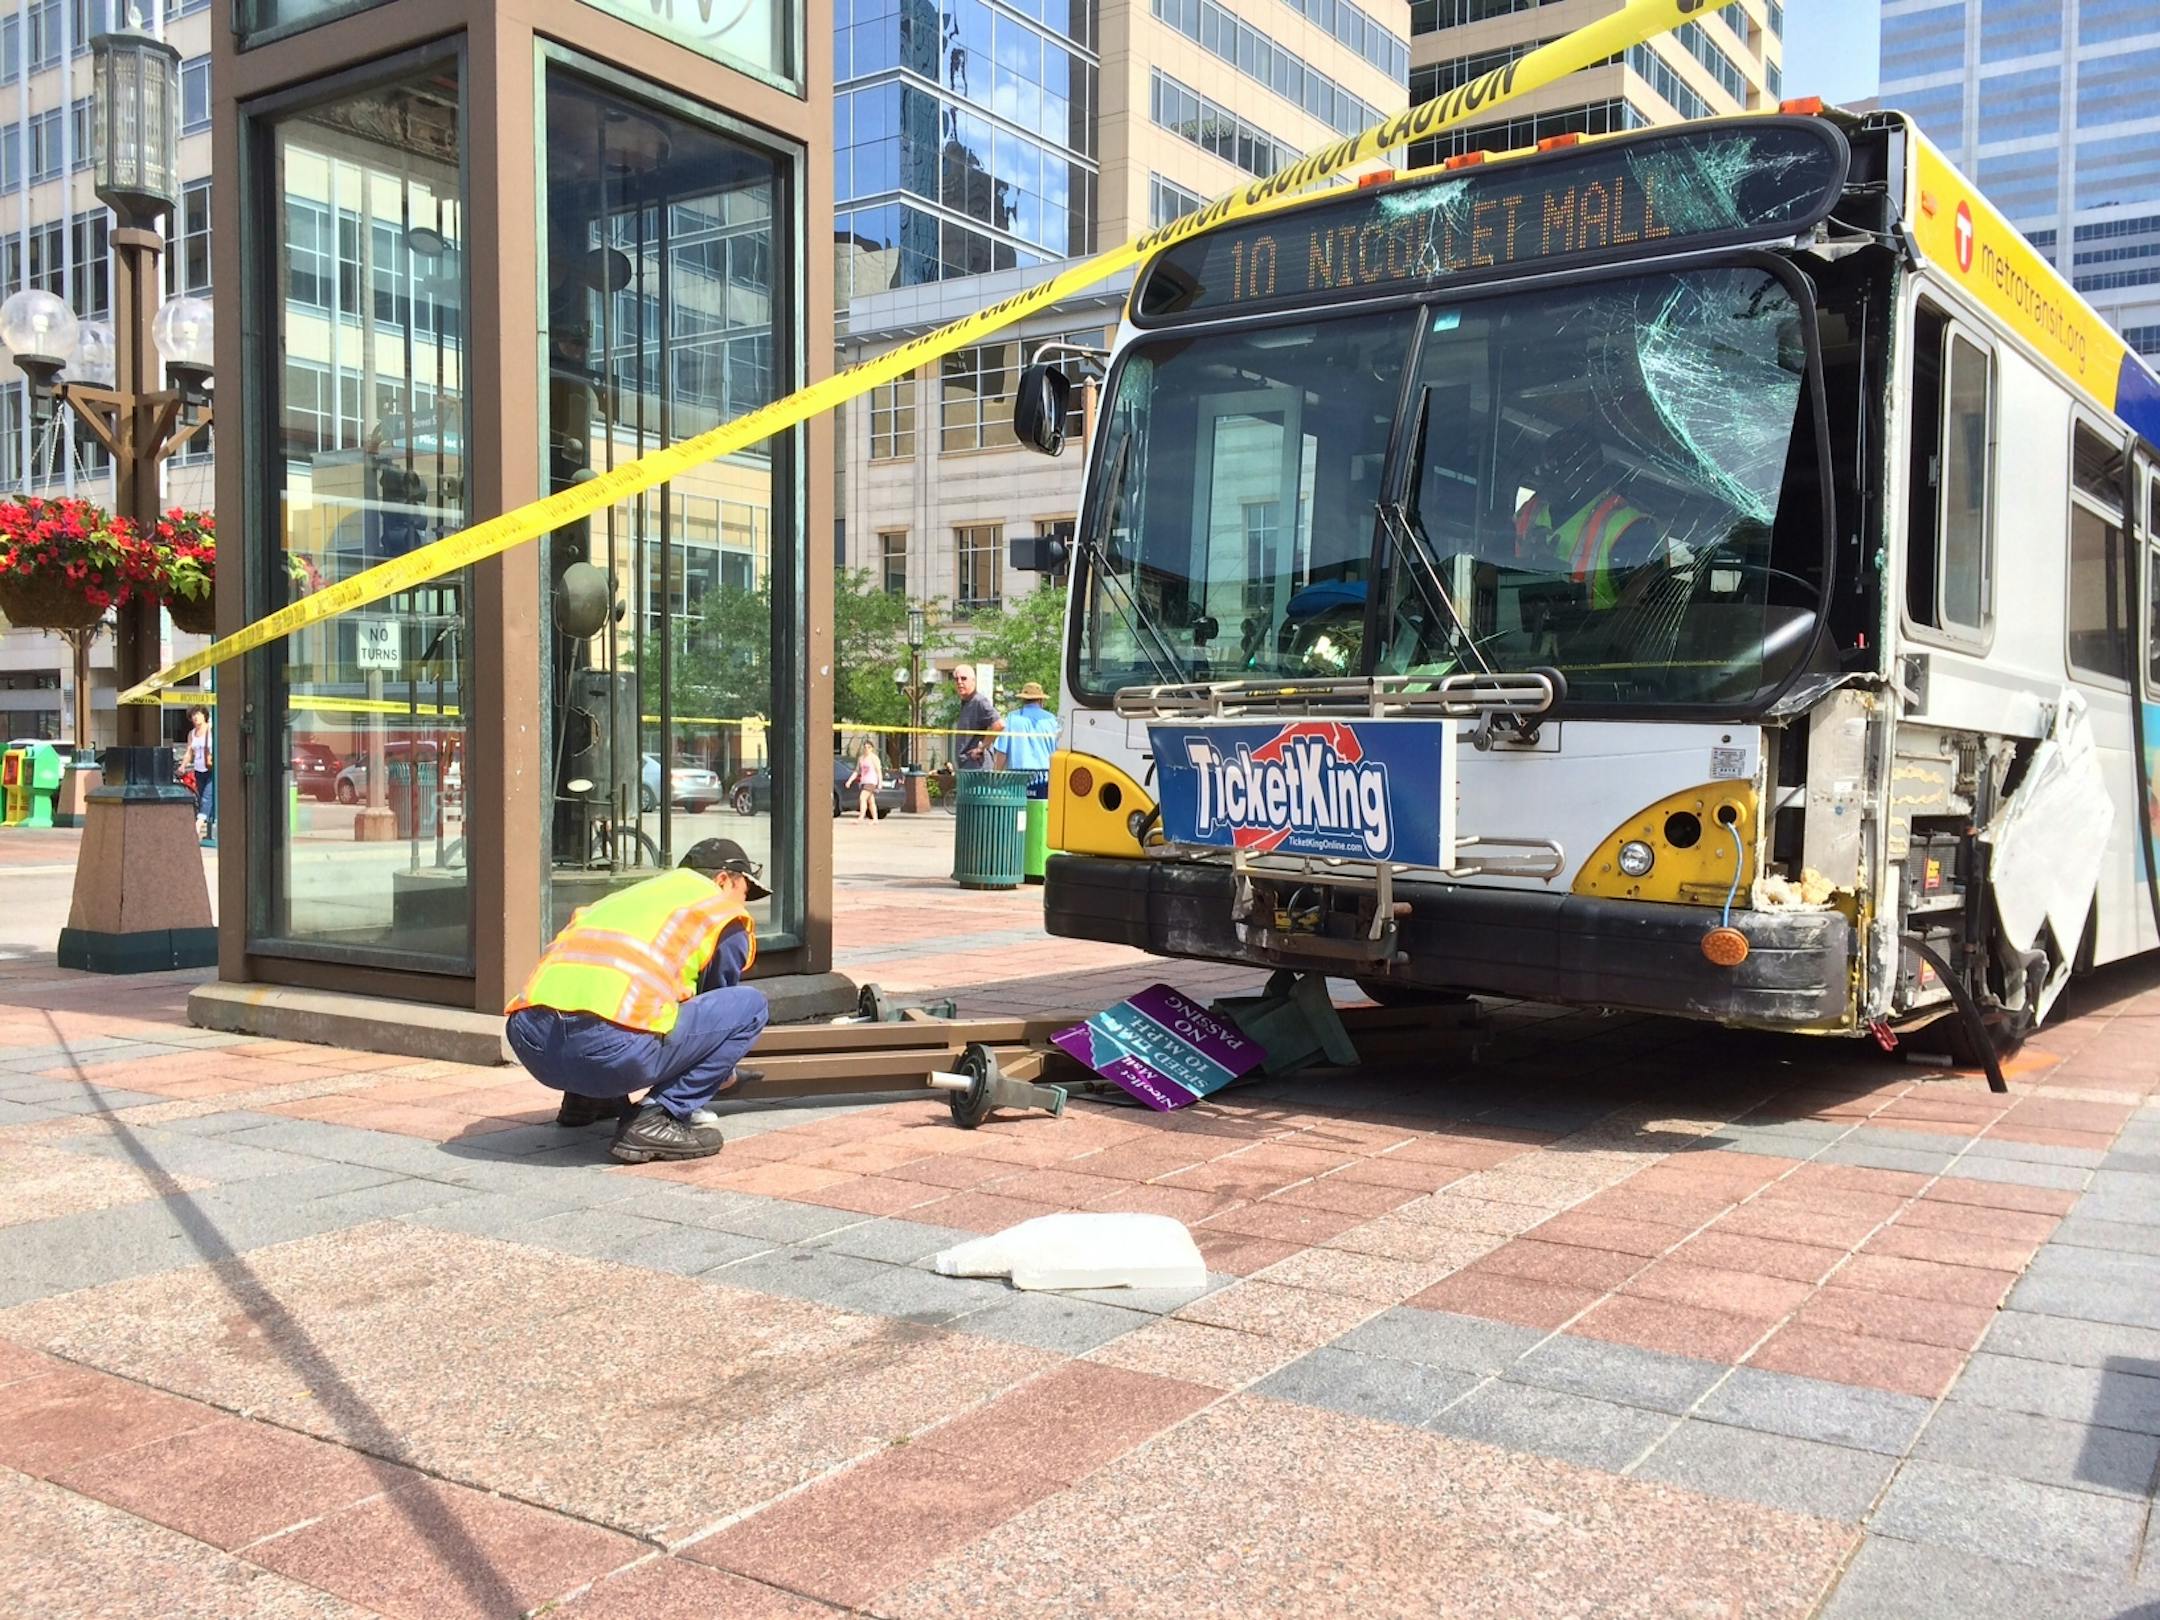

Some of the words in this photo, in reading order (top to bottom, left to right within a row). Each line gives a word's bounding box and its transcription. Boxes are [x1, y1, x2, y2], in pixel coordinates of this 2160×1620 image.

[1137, 193, 1237, 252] CAUTION
[1246, 131, 1367, 205] CAUTION
[1377, 58, 1523, 148] CAUTION
[1231, 236, 1276, 300] 10
[1308, 194, 1523, 289] NICOLLET
[1543, 172, 1670, 255] MALL
[1982, 242, 2087, 375] metrotransit.org
[369, 627, 389, 642] NO
[361, 648, 398, 661] TURNS
[1186, 741, 1390, 855] TicketKing
[1288, 835, 1363, 852] TicketKingOnline.com
[1165, 996, 1245, 1051] PASSING
[1174, 1019, 1207, 1043] NO
[1121, 1055, 1158, 1080] Mall
[1154, 1052, 1209, 1088] SPEED
[1185, 1055, 1210, 1073] 10
[1120, 1069, 1179, 1110] Nicollet
